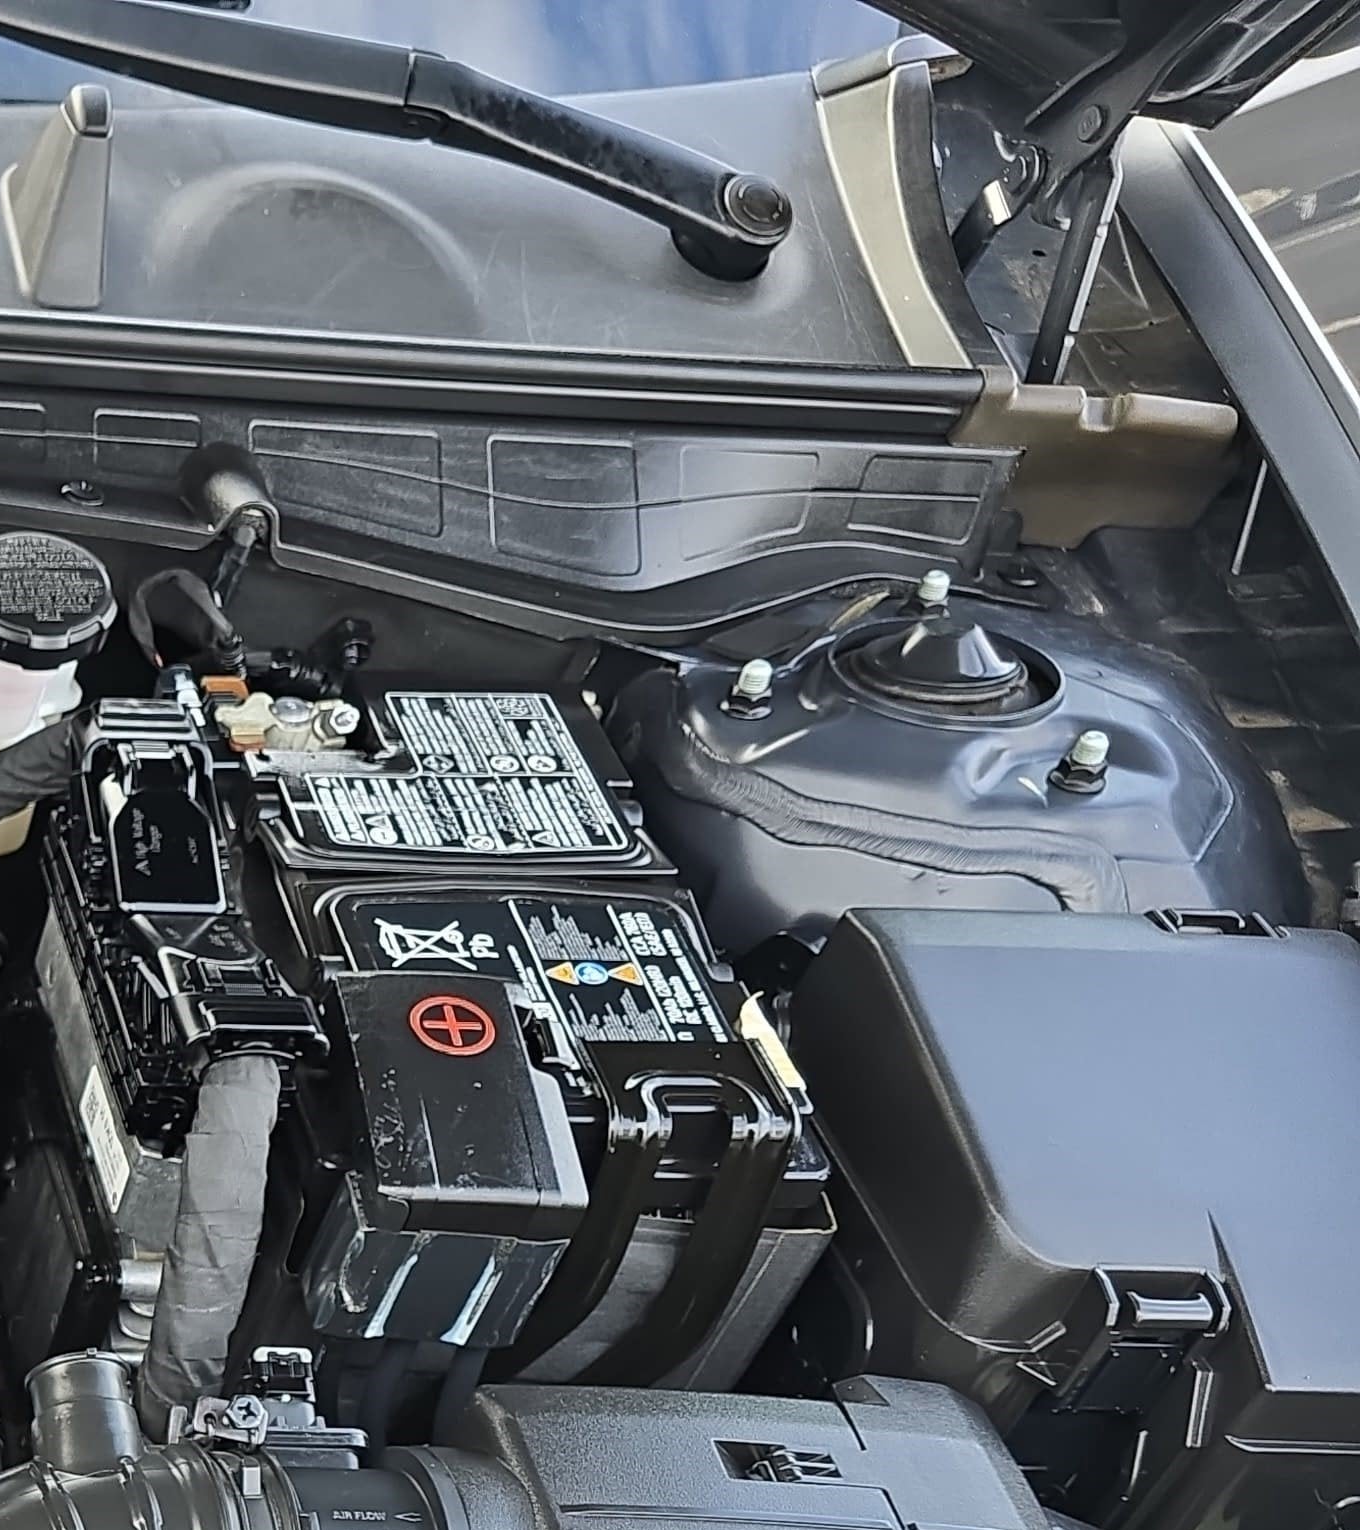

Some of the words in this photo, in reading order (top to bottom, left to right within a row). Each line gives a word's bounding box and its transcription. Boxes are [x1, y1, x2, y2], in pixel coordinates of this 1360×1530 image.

[469, 934, 499, 959] Pb
[332, 1510, 353, 1520] AIR
[355, 1511, 386, 1521] FLOW
